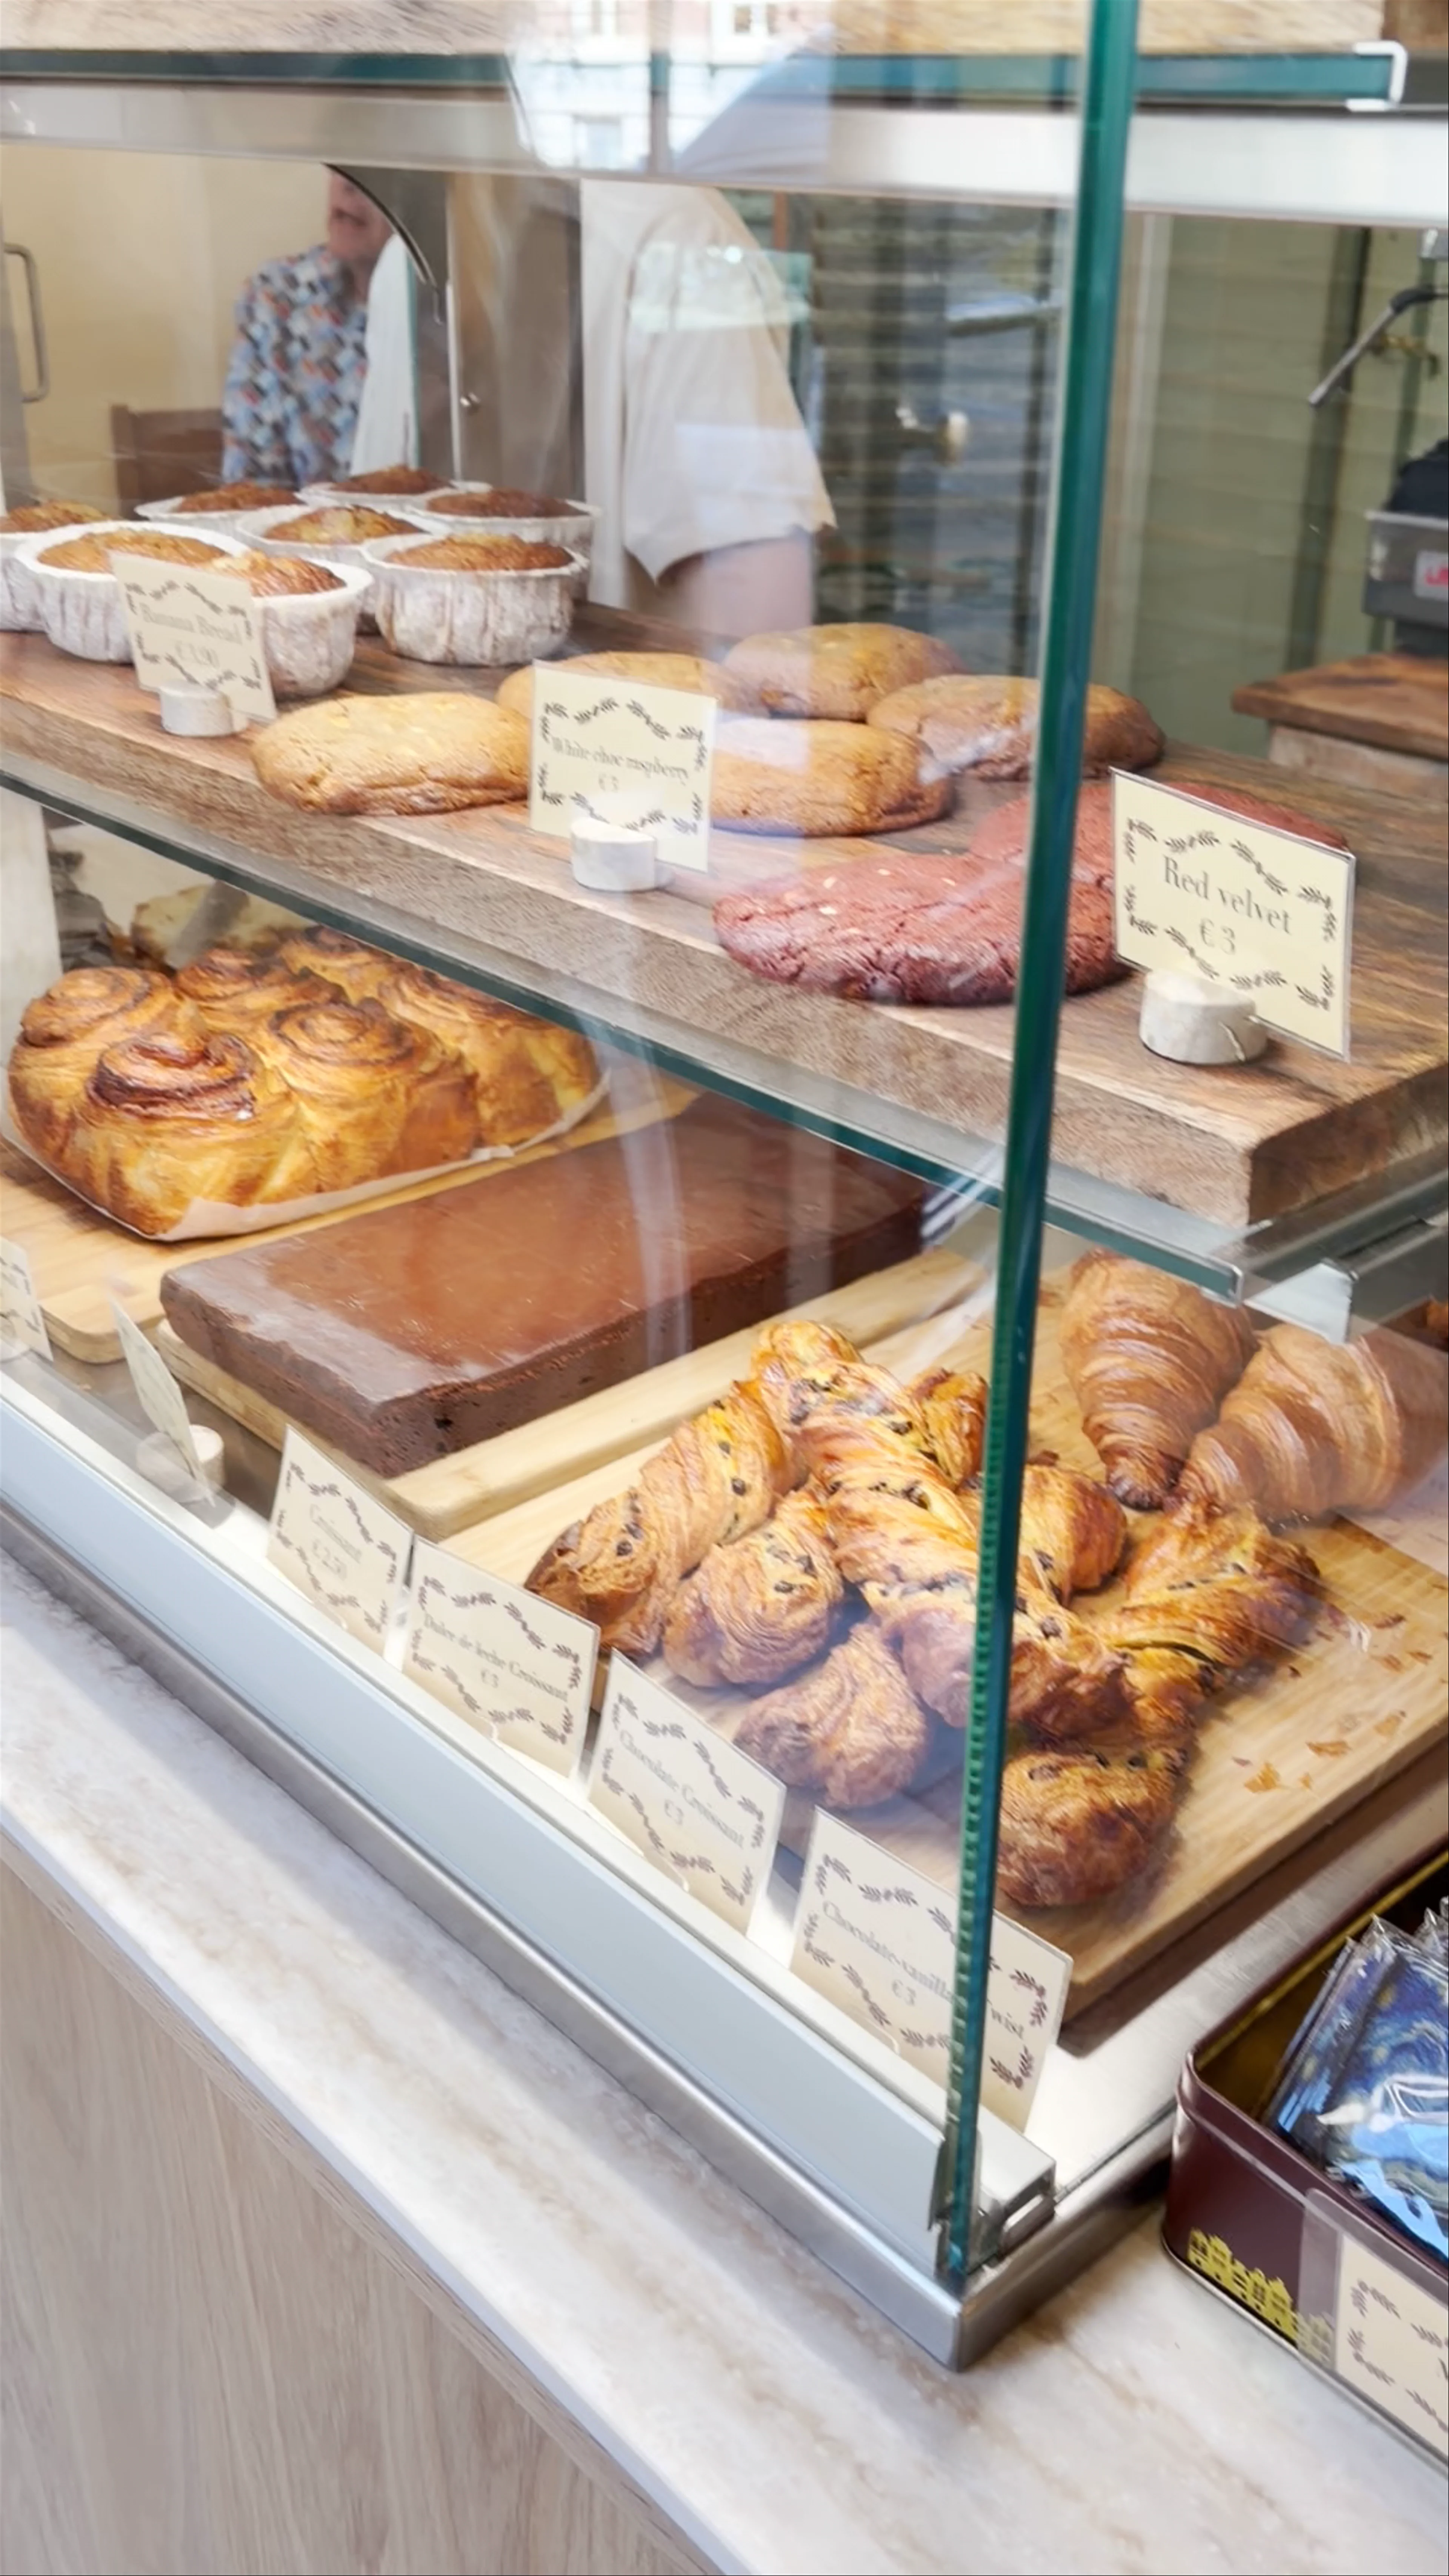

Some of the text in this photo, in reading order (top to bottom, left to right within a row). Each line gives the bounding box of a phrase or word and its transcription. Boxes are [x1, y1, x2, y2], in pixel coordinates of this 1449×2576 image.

[593, 745, 625, 767] choc
[1163, 855, 1293, 935] Red velvet
[458, 1634, 474, 1650] de
[475, 1640, 506, 1669] leche
[509, 1661, 569, 1702] Croissant
[619, 1729, 746, 1850] Chocolate Croissant
[987, 1999, 1024, 2040] wist
